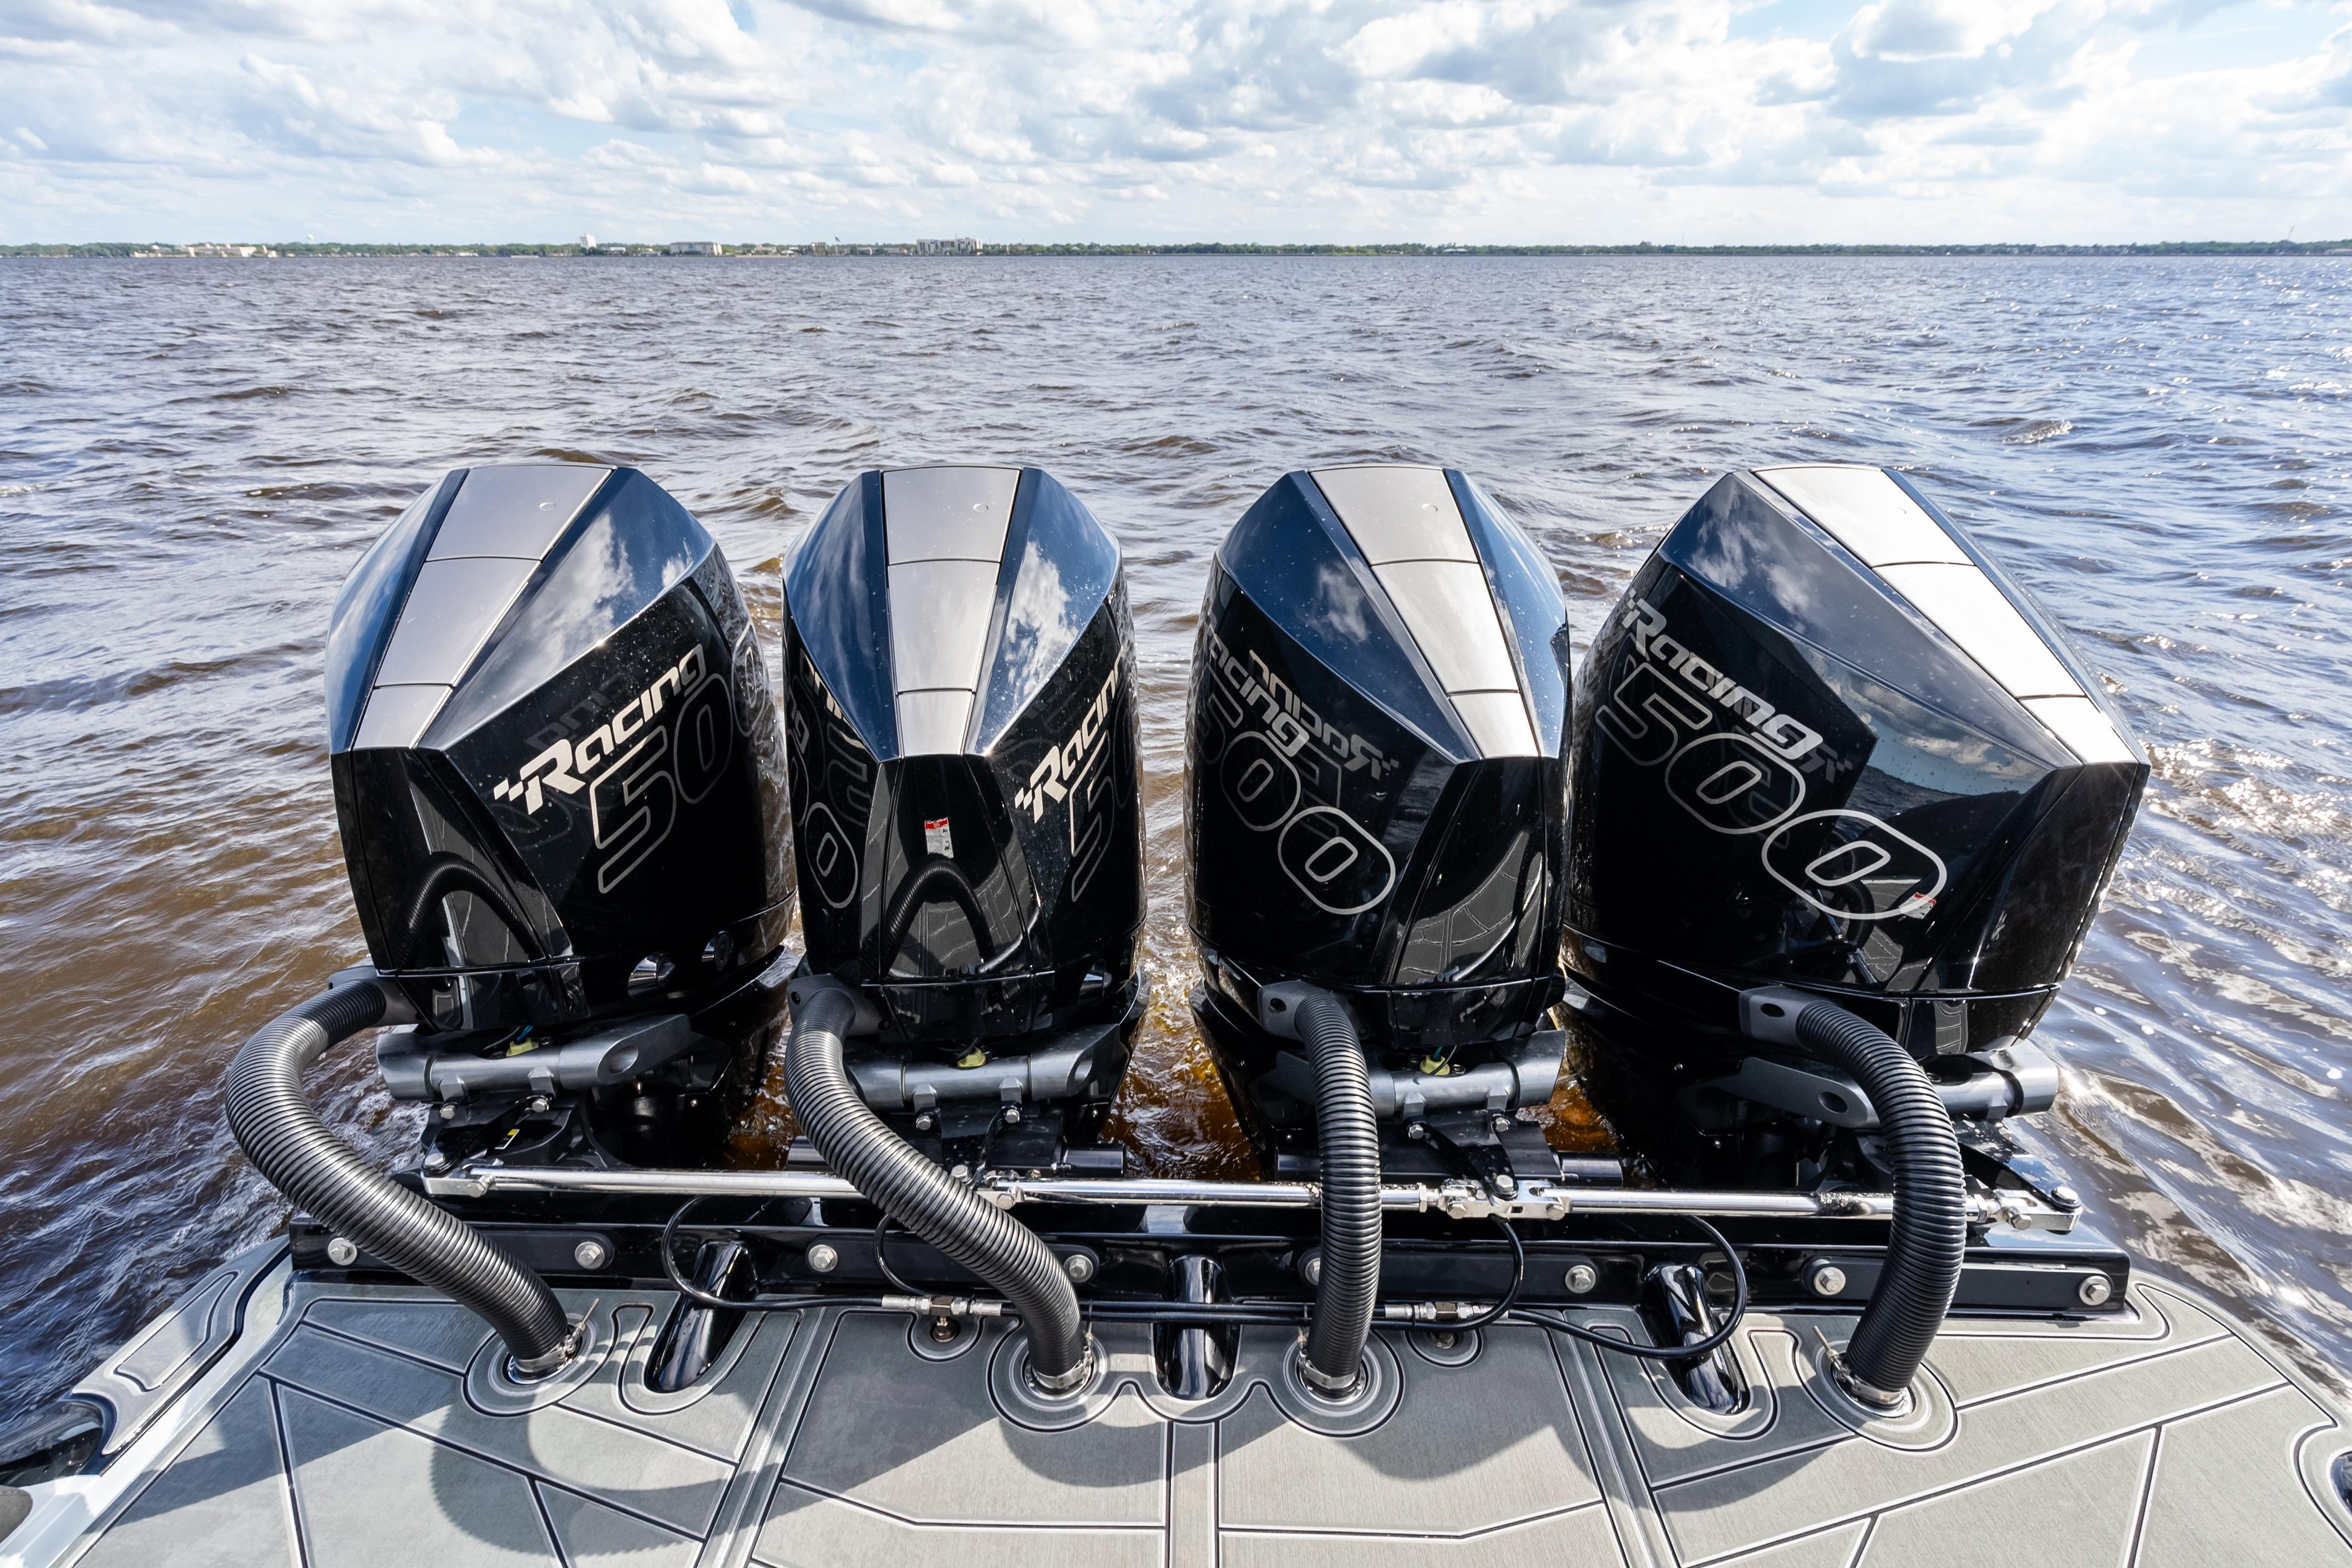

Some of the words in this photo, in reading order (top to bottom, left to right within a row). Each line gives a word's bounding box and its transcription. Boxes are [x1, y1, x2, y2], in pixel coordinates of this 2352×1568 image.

[519, 643, 706, 815] Racing
[590, 621, 767, 894] 500
[1197, 662, 1396, 915] 500
[1595, 662, 1947, 920] 500
[1621, 598, 1823, 760] Racing
